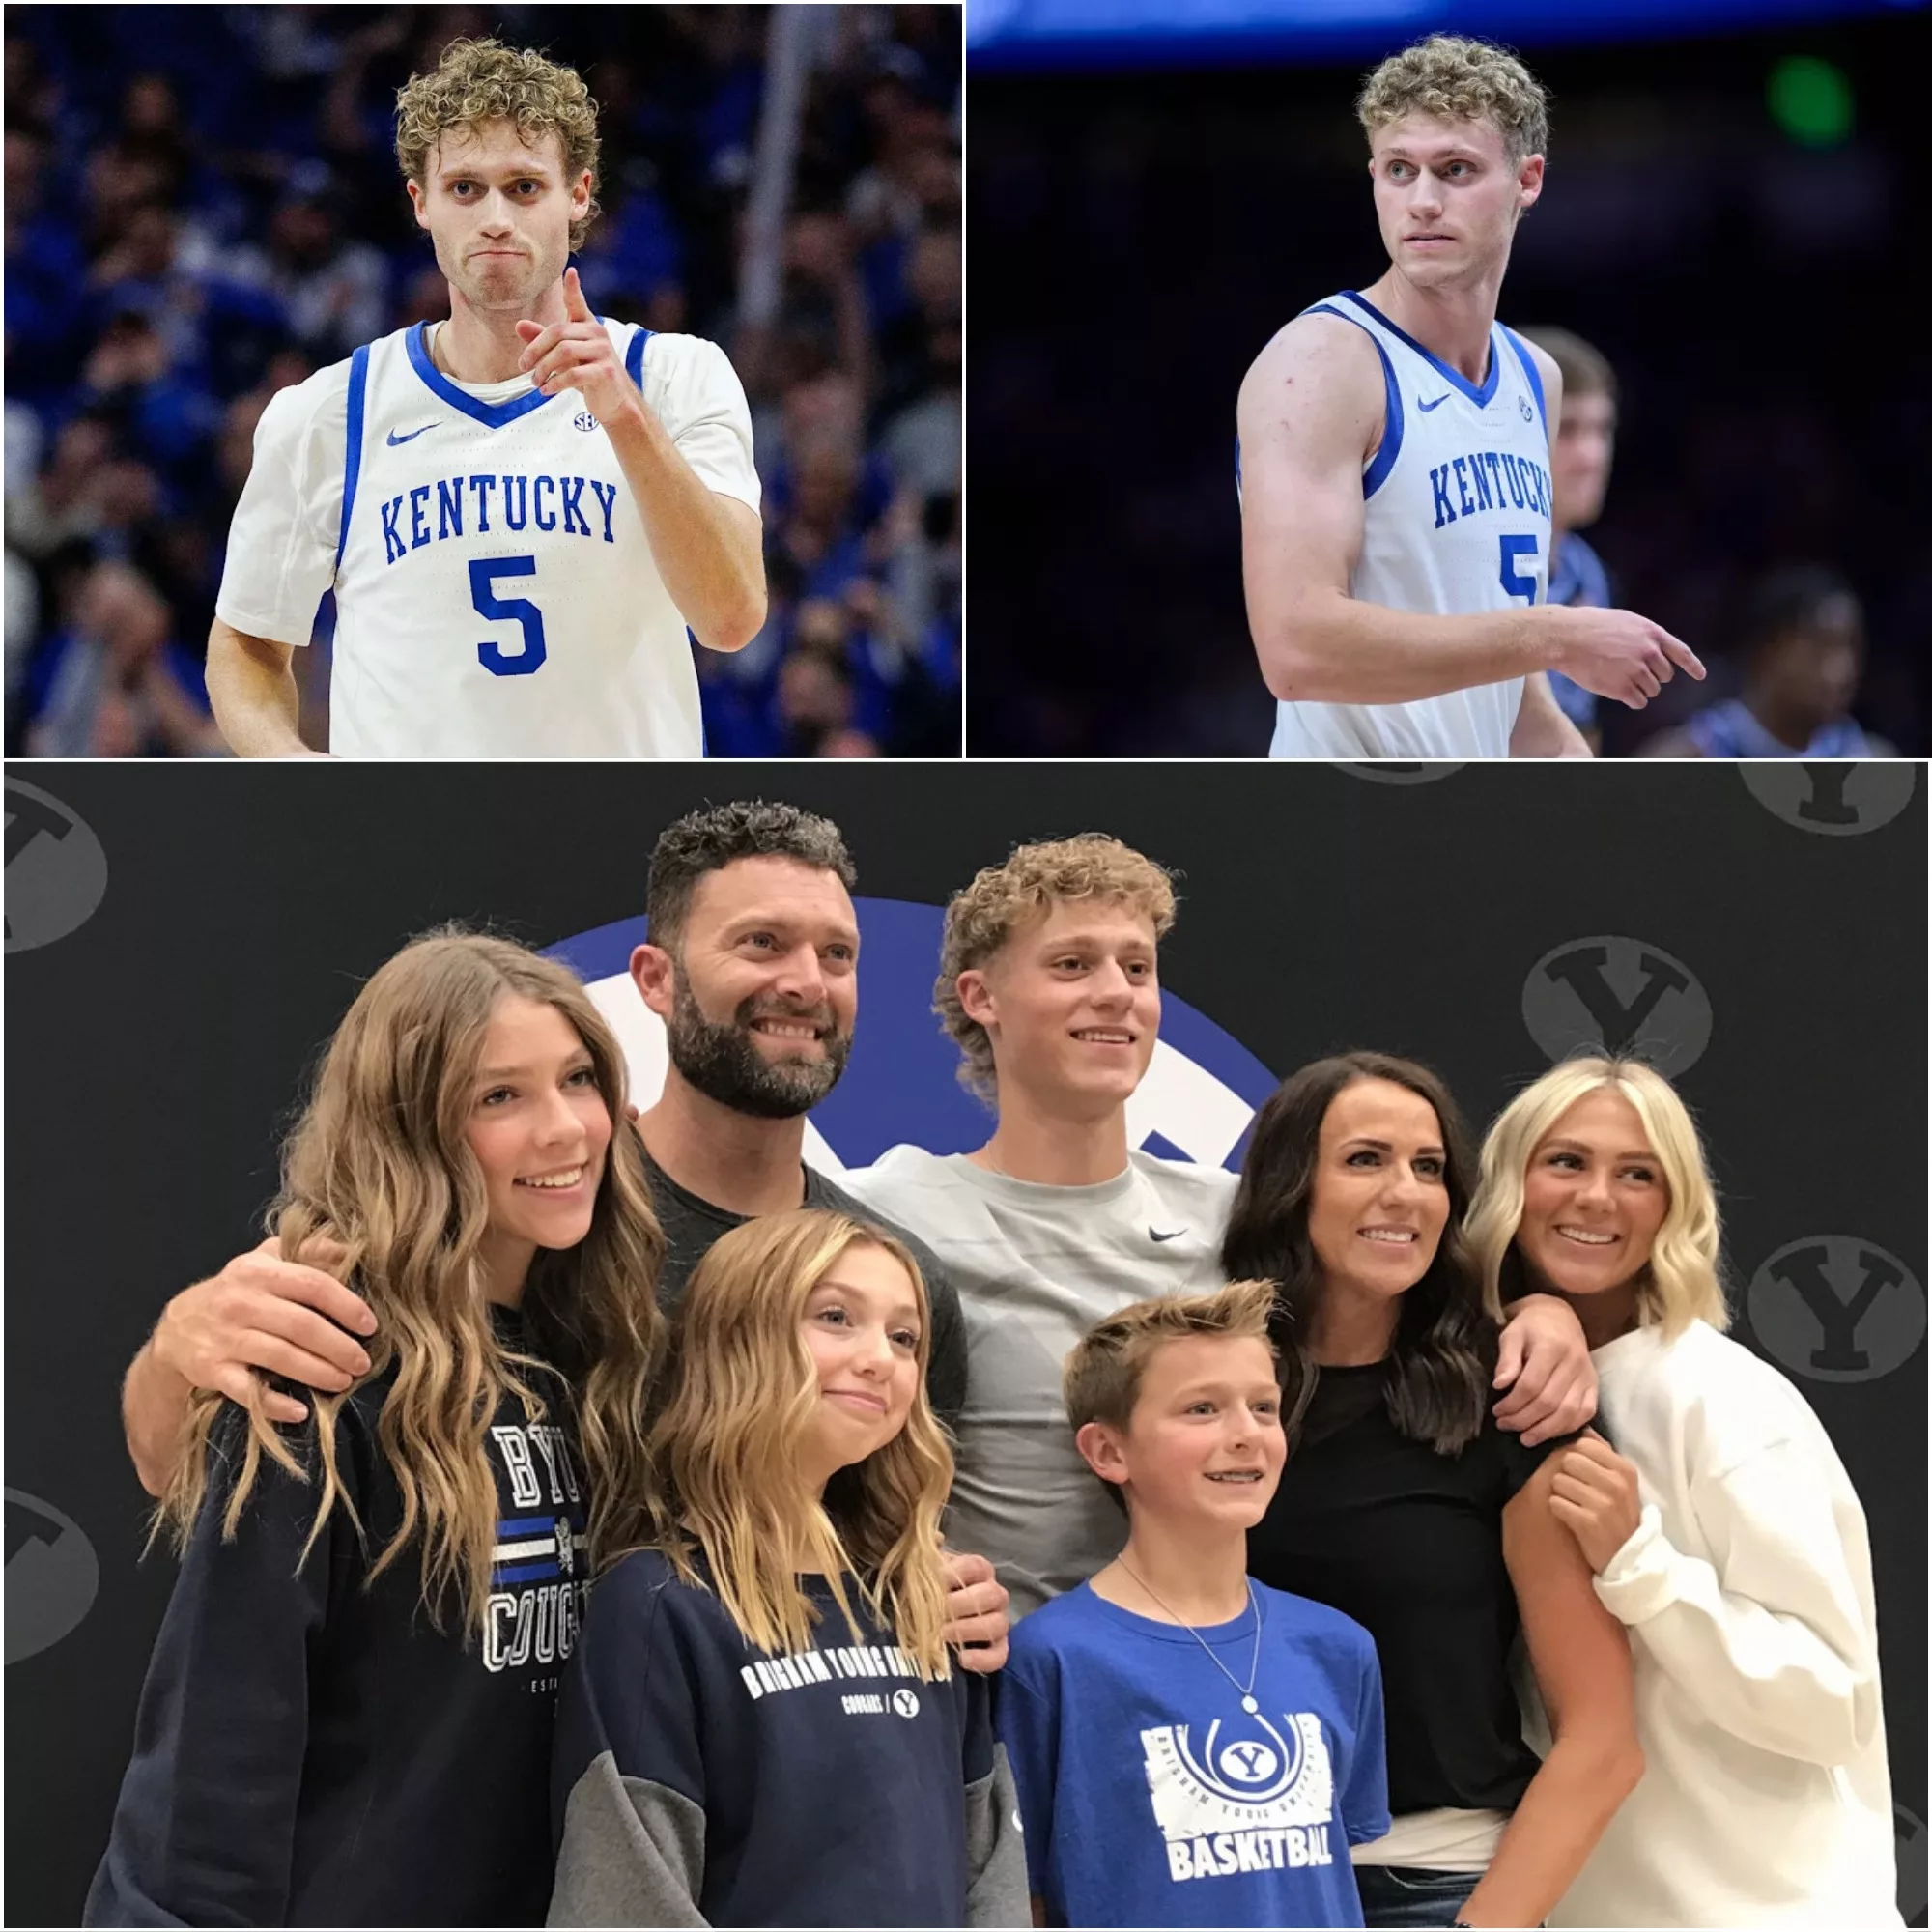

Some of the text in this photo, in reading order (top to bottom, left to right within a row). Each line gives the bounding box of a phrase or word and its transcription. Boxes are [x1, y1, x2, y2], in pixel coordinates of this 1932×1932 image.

[381, 474, 616, 565] KENTUCKY
[468, 554, 547, 676] 5
[1499, 534, 1539, 607] 5
[1769, 1244, 1903, 1371] Y
[483, 1581, 580, 1673] COUG
[740, 1650, 832, 1700] BRIGHAM
[824, 1645, 888, 1679] YOUNG
[1230, 1746, 1264, 1776] Y
